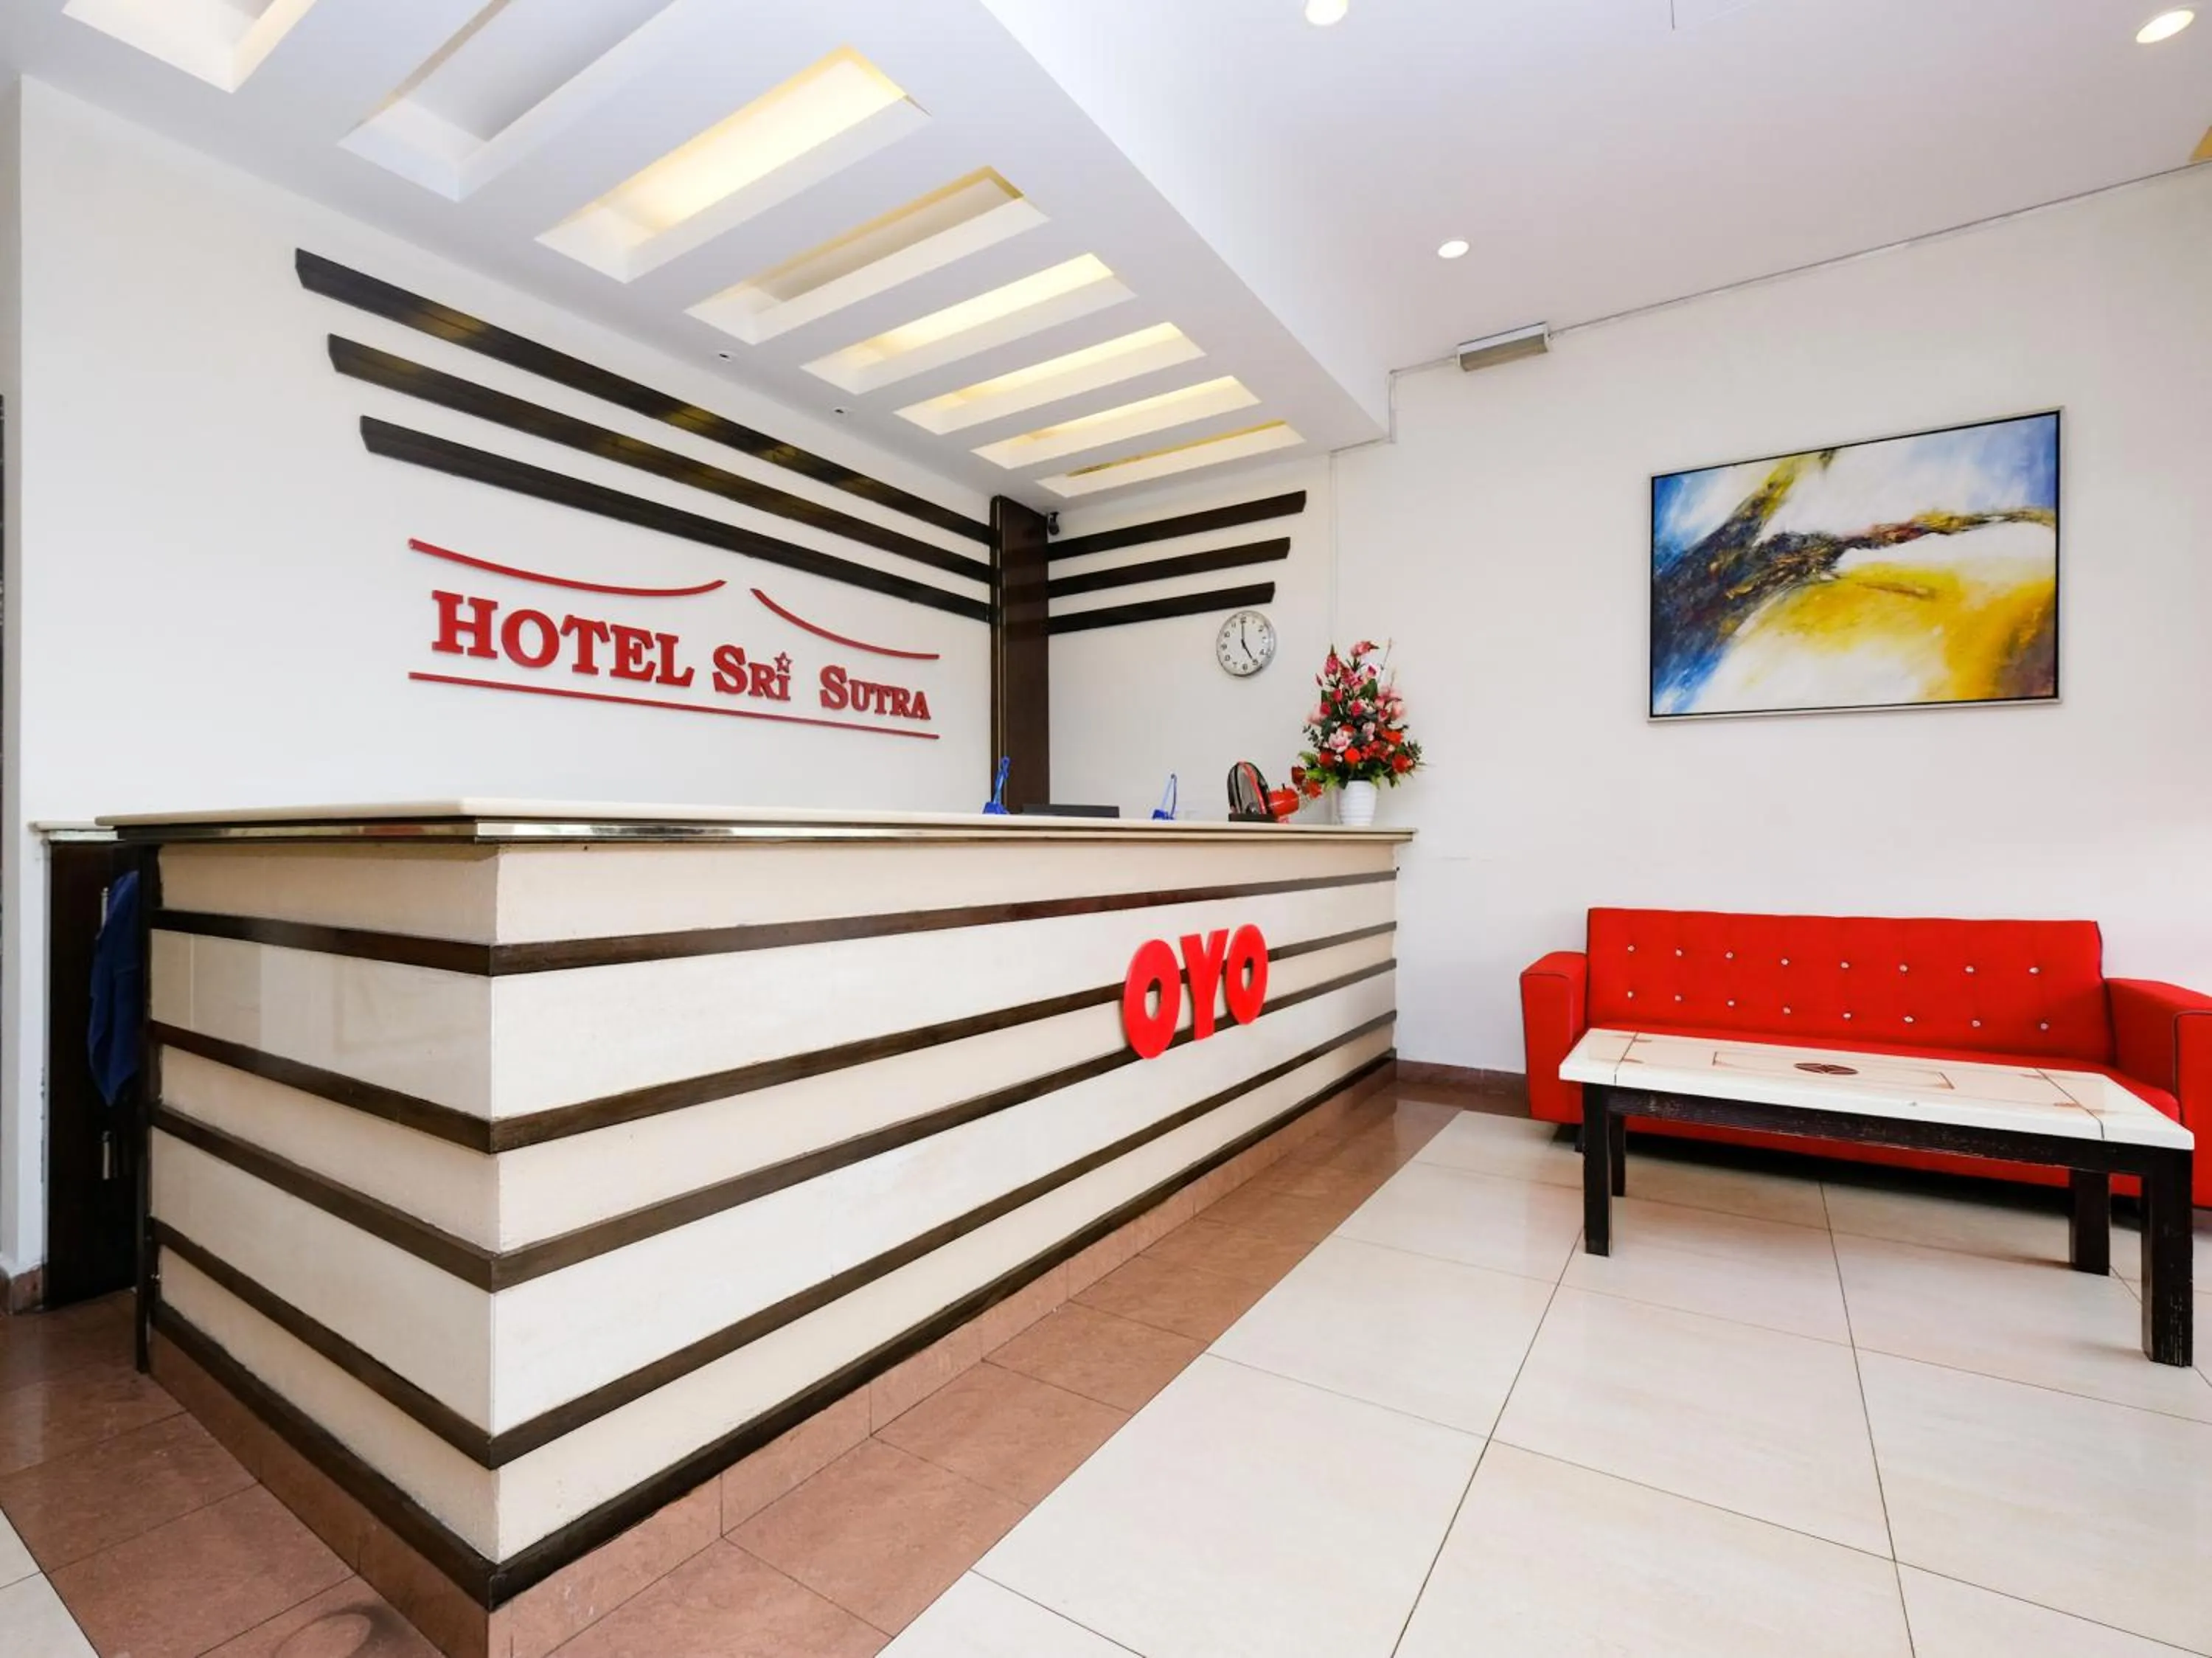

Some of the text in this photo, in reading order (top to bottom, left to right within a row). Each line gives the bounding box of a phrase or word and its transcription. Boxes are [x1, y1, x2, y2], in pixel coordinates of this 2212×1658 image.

[431, 589, 695, 687] HOTEL
[819, 665, 931, 720] SUTRA
[1123, 923, 1268, 1059] OYO
